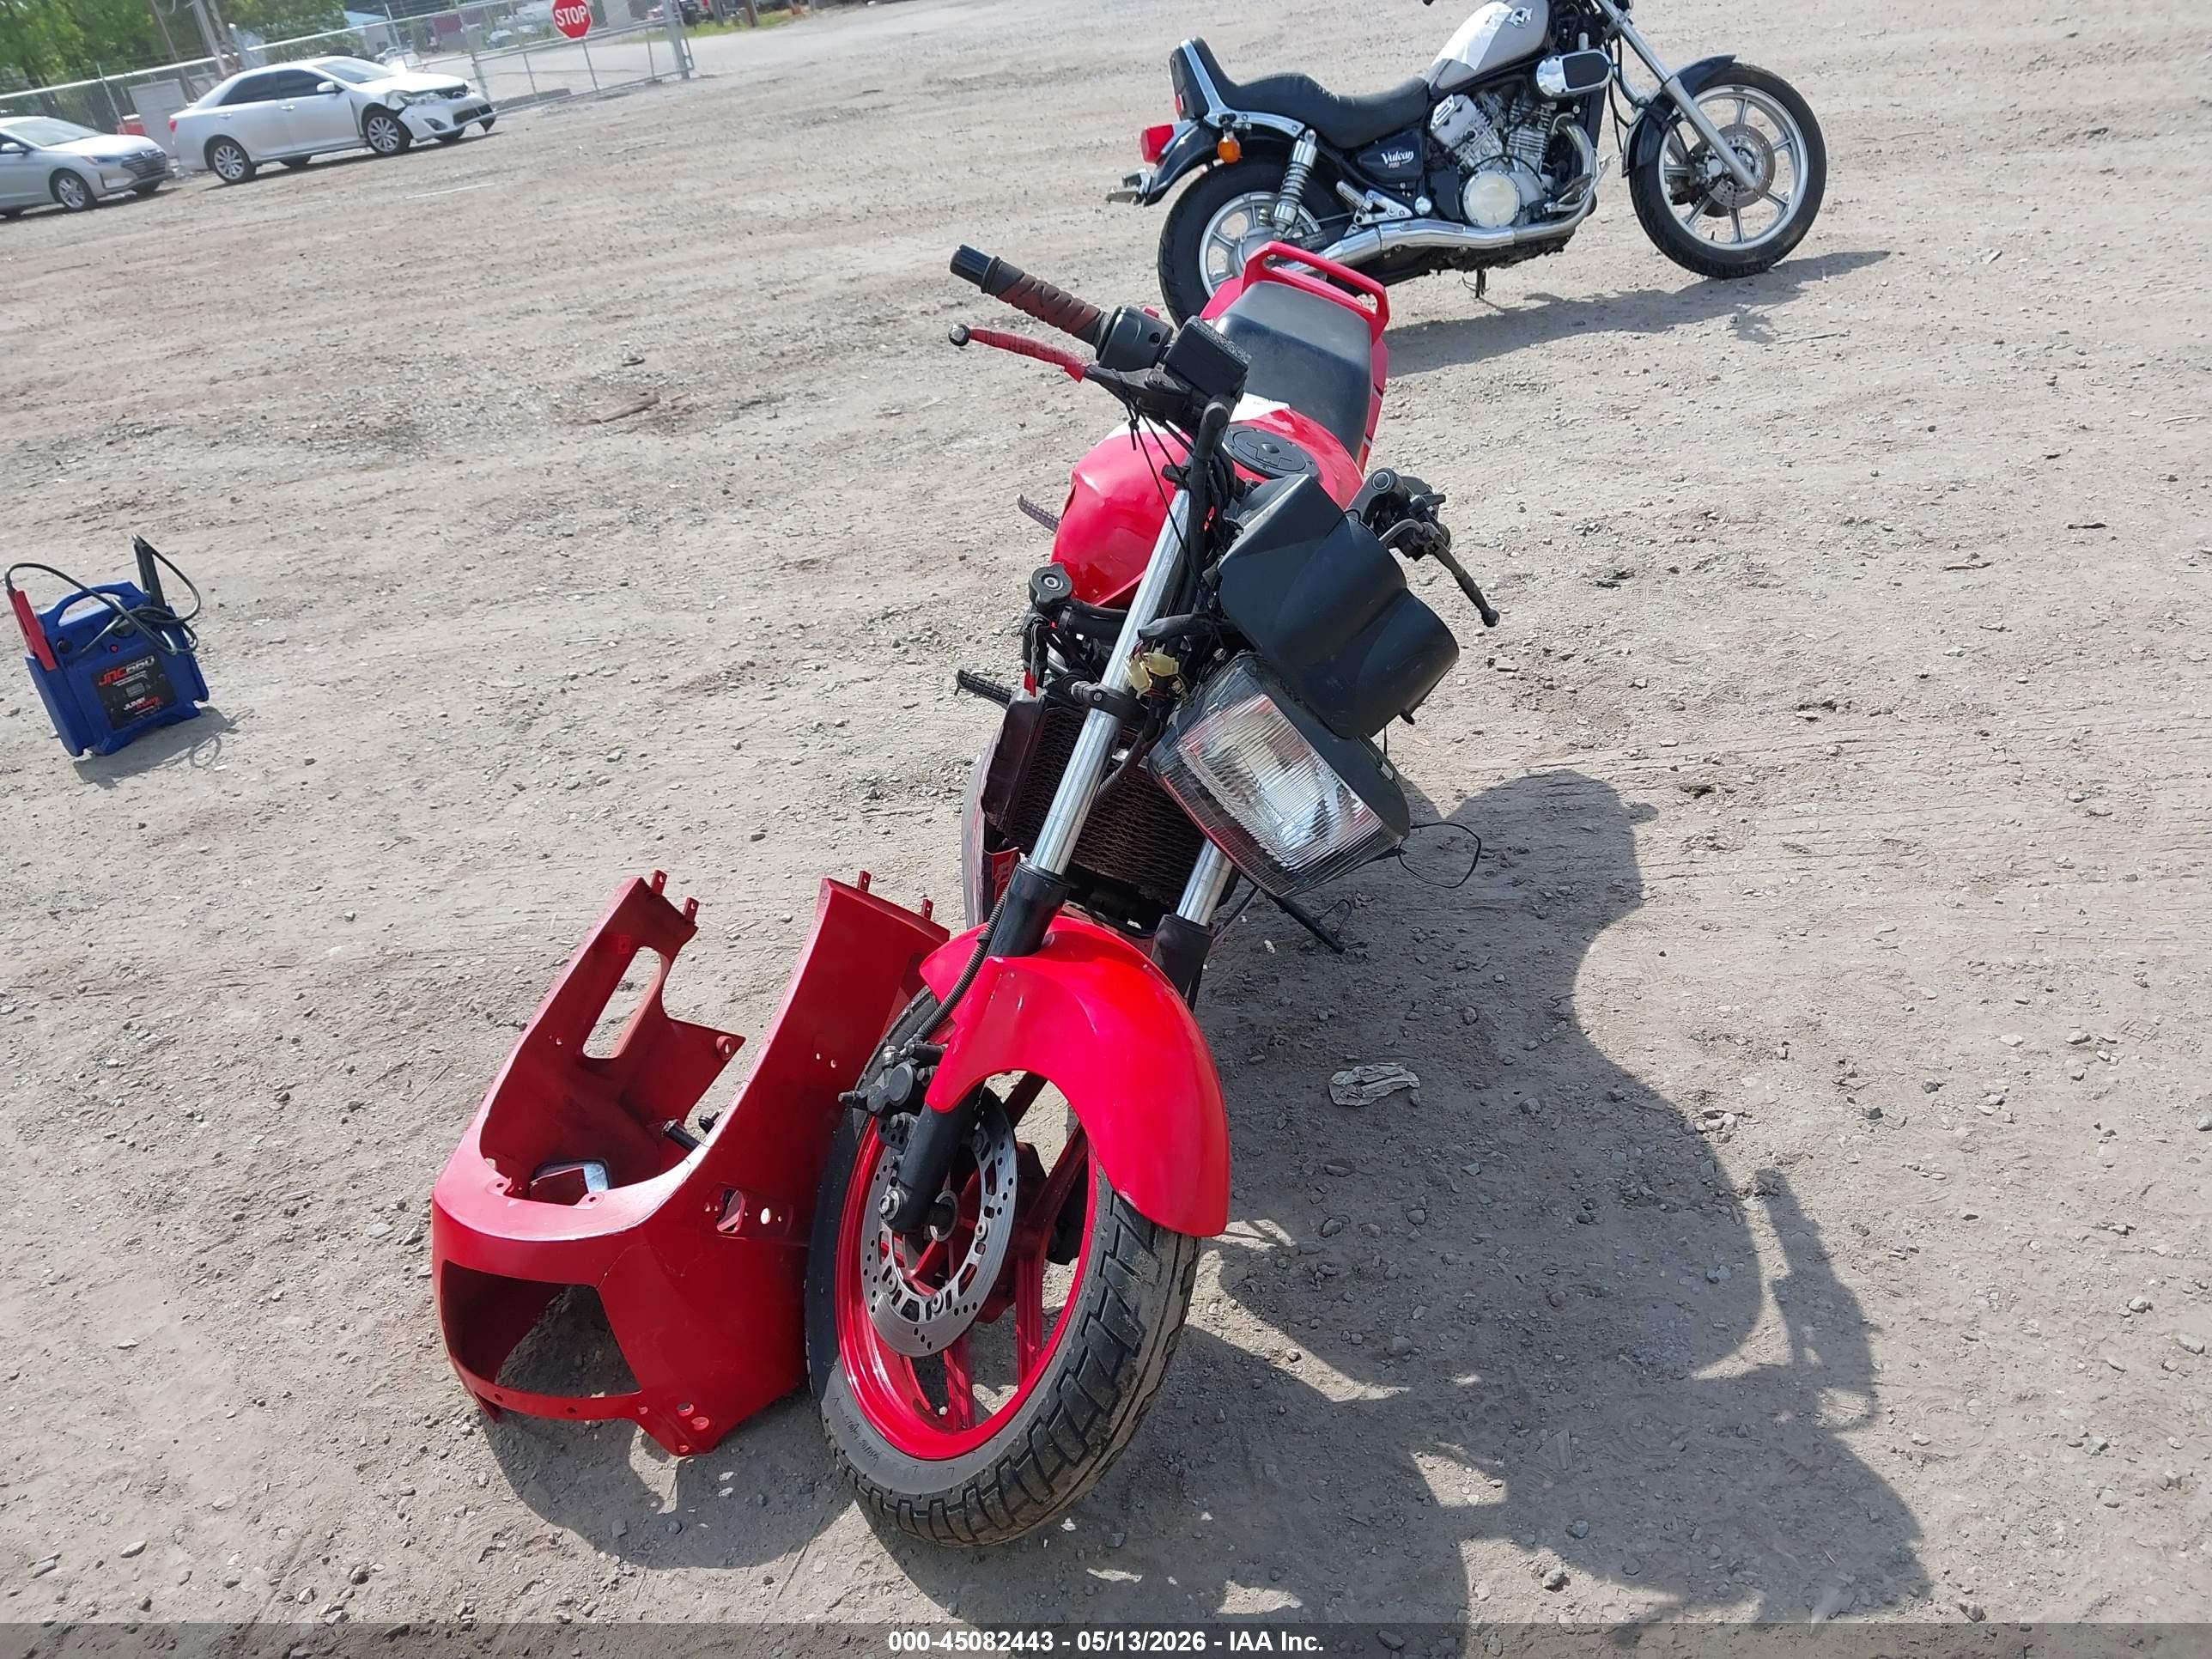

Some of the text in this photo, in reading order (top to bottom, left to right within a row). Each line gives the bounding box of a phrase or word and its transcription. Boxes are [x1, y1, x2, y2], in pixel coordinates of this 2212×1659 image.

[555, 5, 586, 27] STOP
[1380, 150, 1414, 165] Vulcan
[98, 654, 155, 687] JNC660
